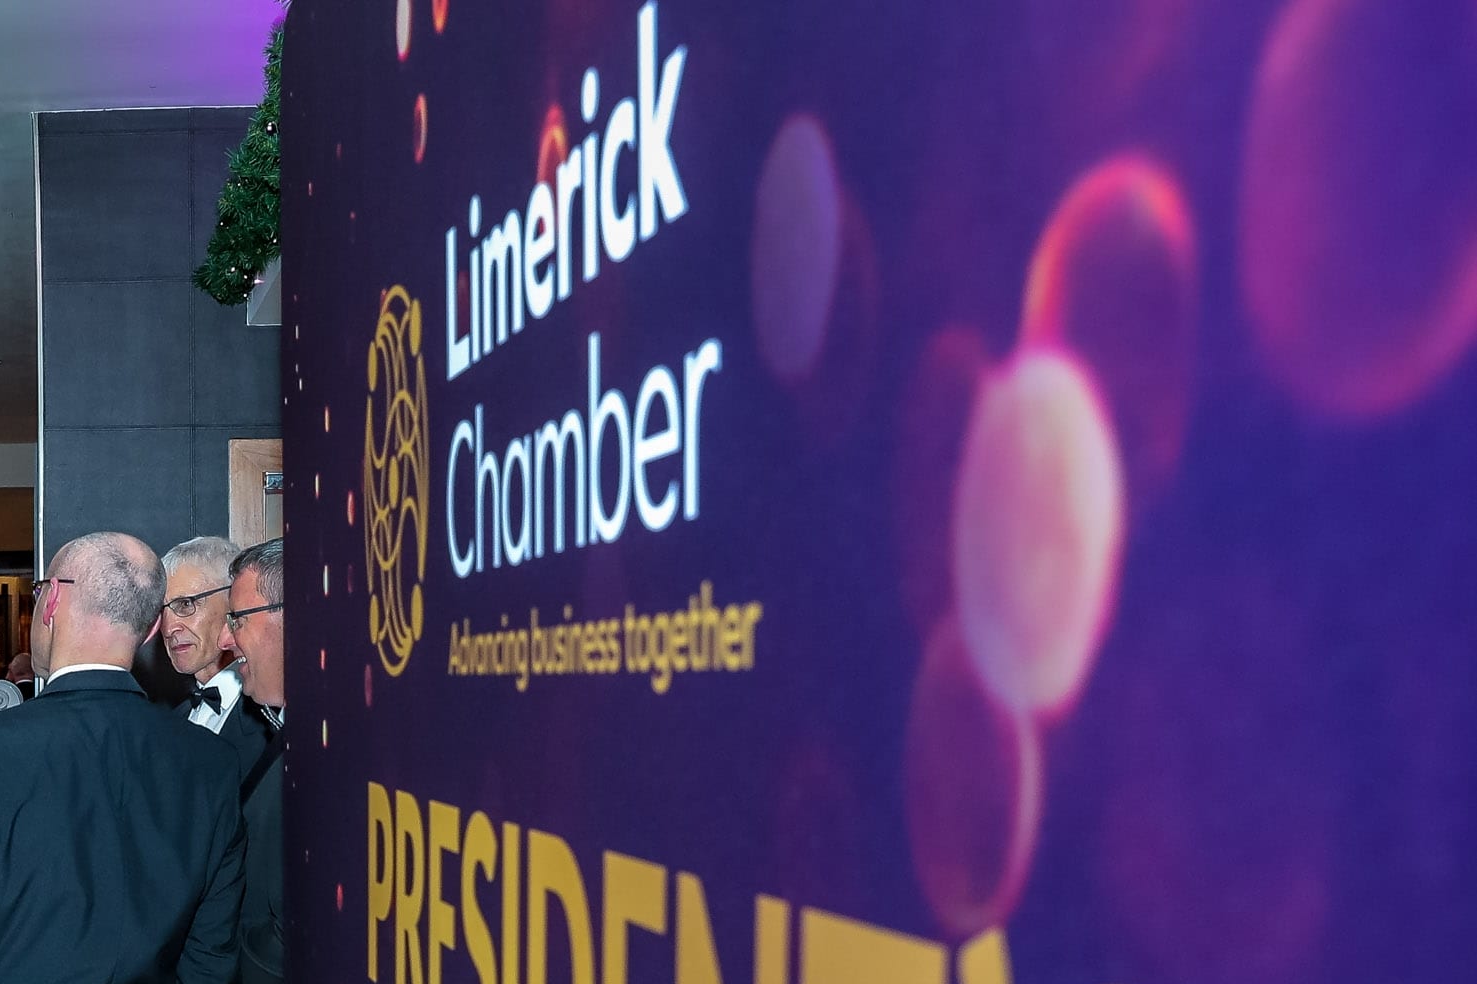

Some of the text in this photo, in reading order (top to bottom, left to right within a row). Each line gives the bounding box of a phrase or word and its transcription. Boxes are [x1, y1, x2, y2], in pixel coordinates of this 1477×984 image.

[446, 0, 689, 381] Limerick
[446, 332, 723, 578] Chamber
[448, 579, 763, 694] Advancing business together
